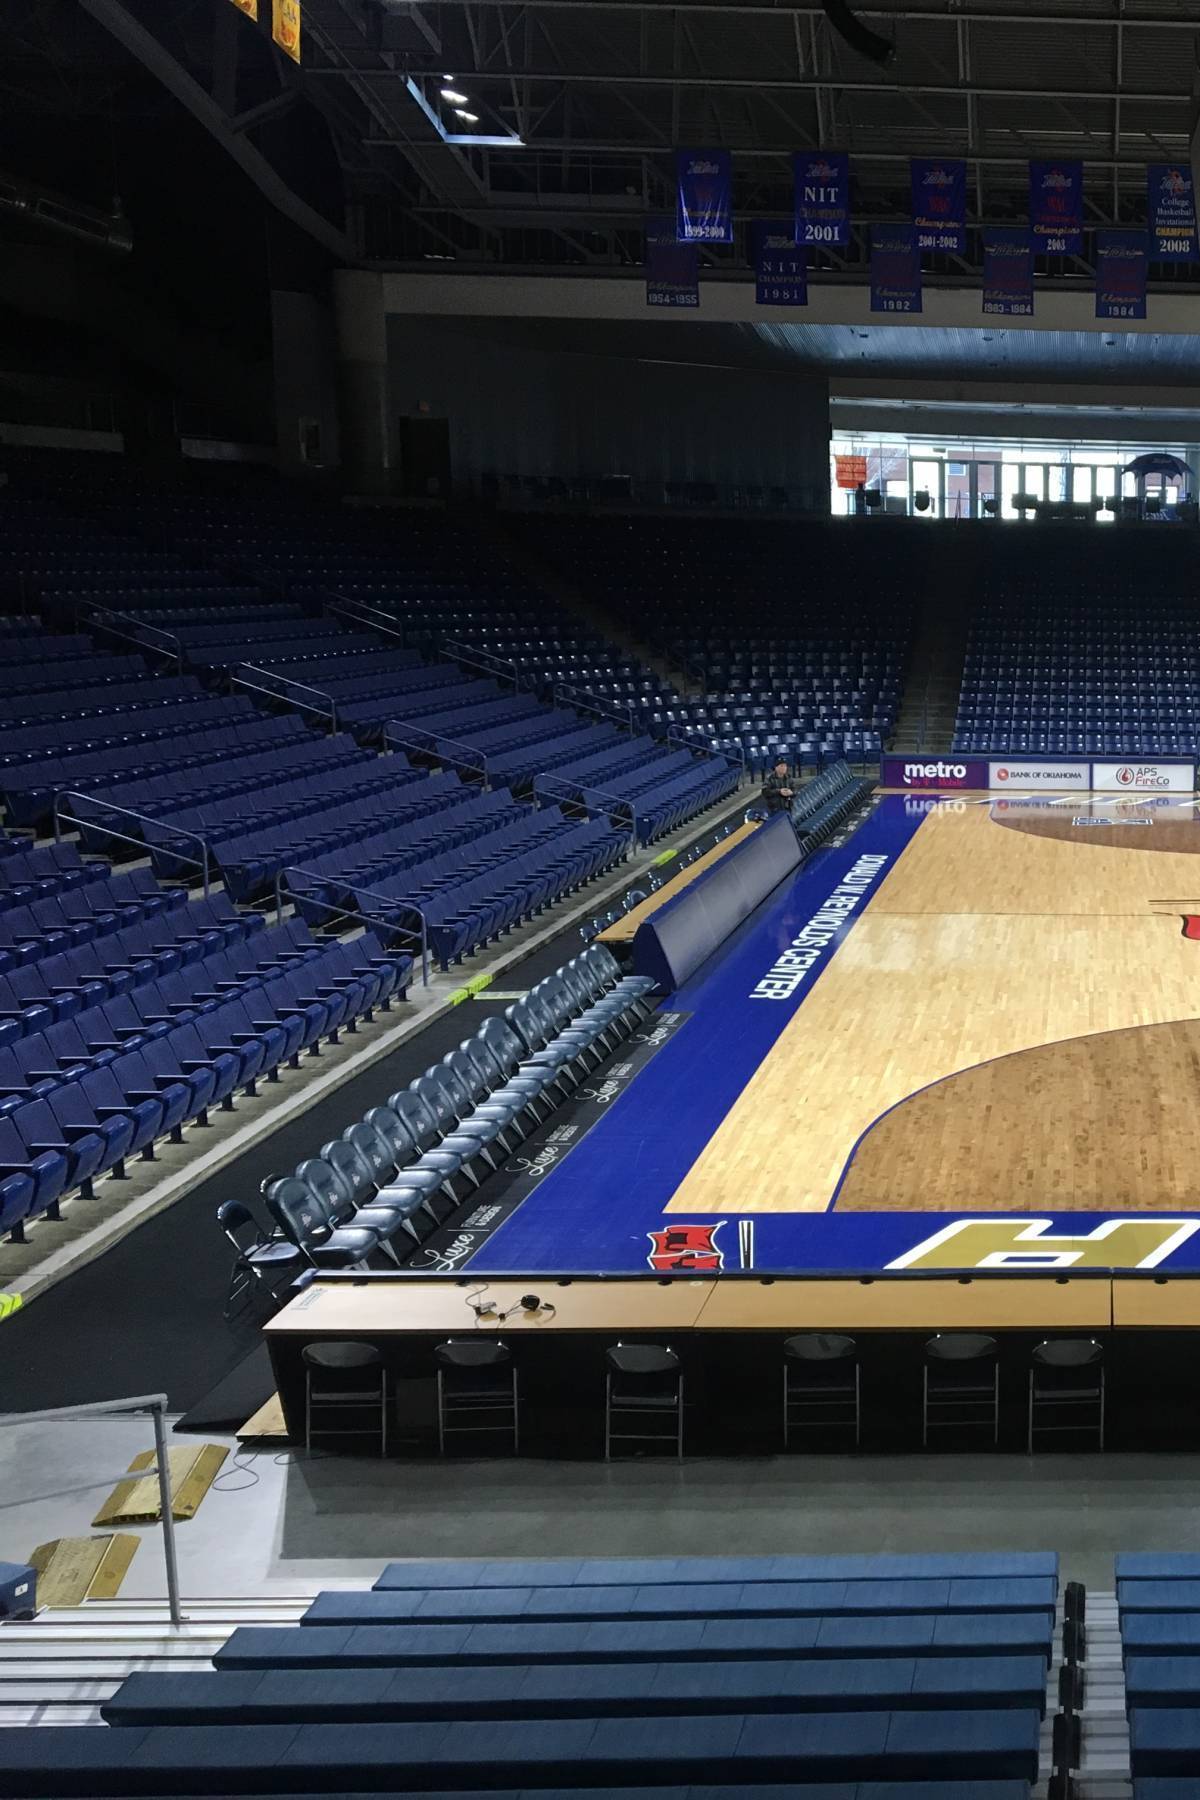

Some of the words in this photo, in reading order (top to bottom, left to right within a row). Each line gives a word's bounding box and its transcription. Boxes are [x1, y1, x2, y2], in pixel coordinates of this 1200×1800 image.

[804, 187, 839, 202] NIT
[805, 225, 840, 241] 2001
[918, 235, 958, 248] 2001-2002
[1047, 238, 1066, 251] 2003
[1159, 239, 1190, 253] 2008
[763, 288, 800, 299] 1981
[882, 300, 911, 310] 1982
[1108, 306, 1134, 316] 1984
[904, 761, 966, 779] metro
[1043, 772, 1082, 780] OKLAHOMA
[1136, 767, 1157, 776] APS
[842, 854, 889, 884] DONALD
[791, 895, 861, 947] REYNOLDS
[749, 948, 822, 1000] CENTER
[505, 1145, 559, 1176] Luxe
[409, 1233, 475, 1271] Luxe
